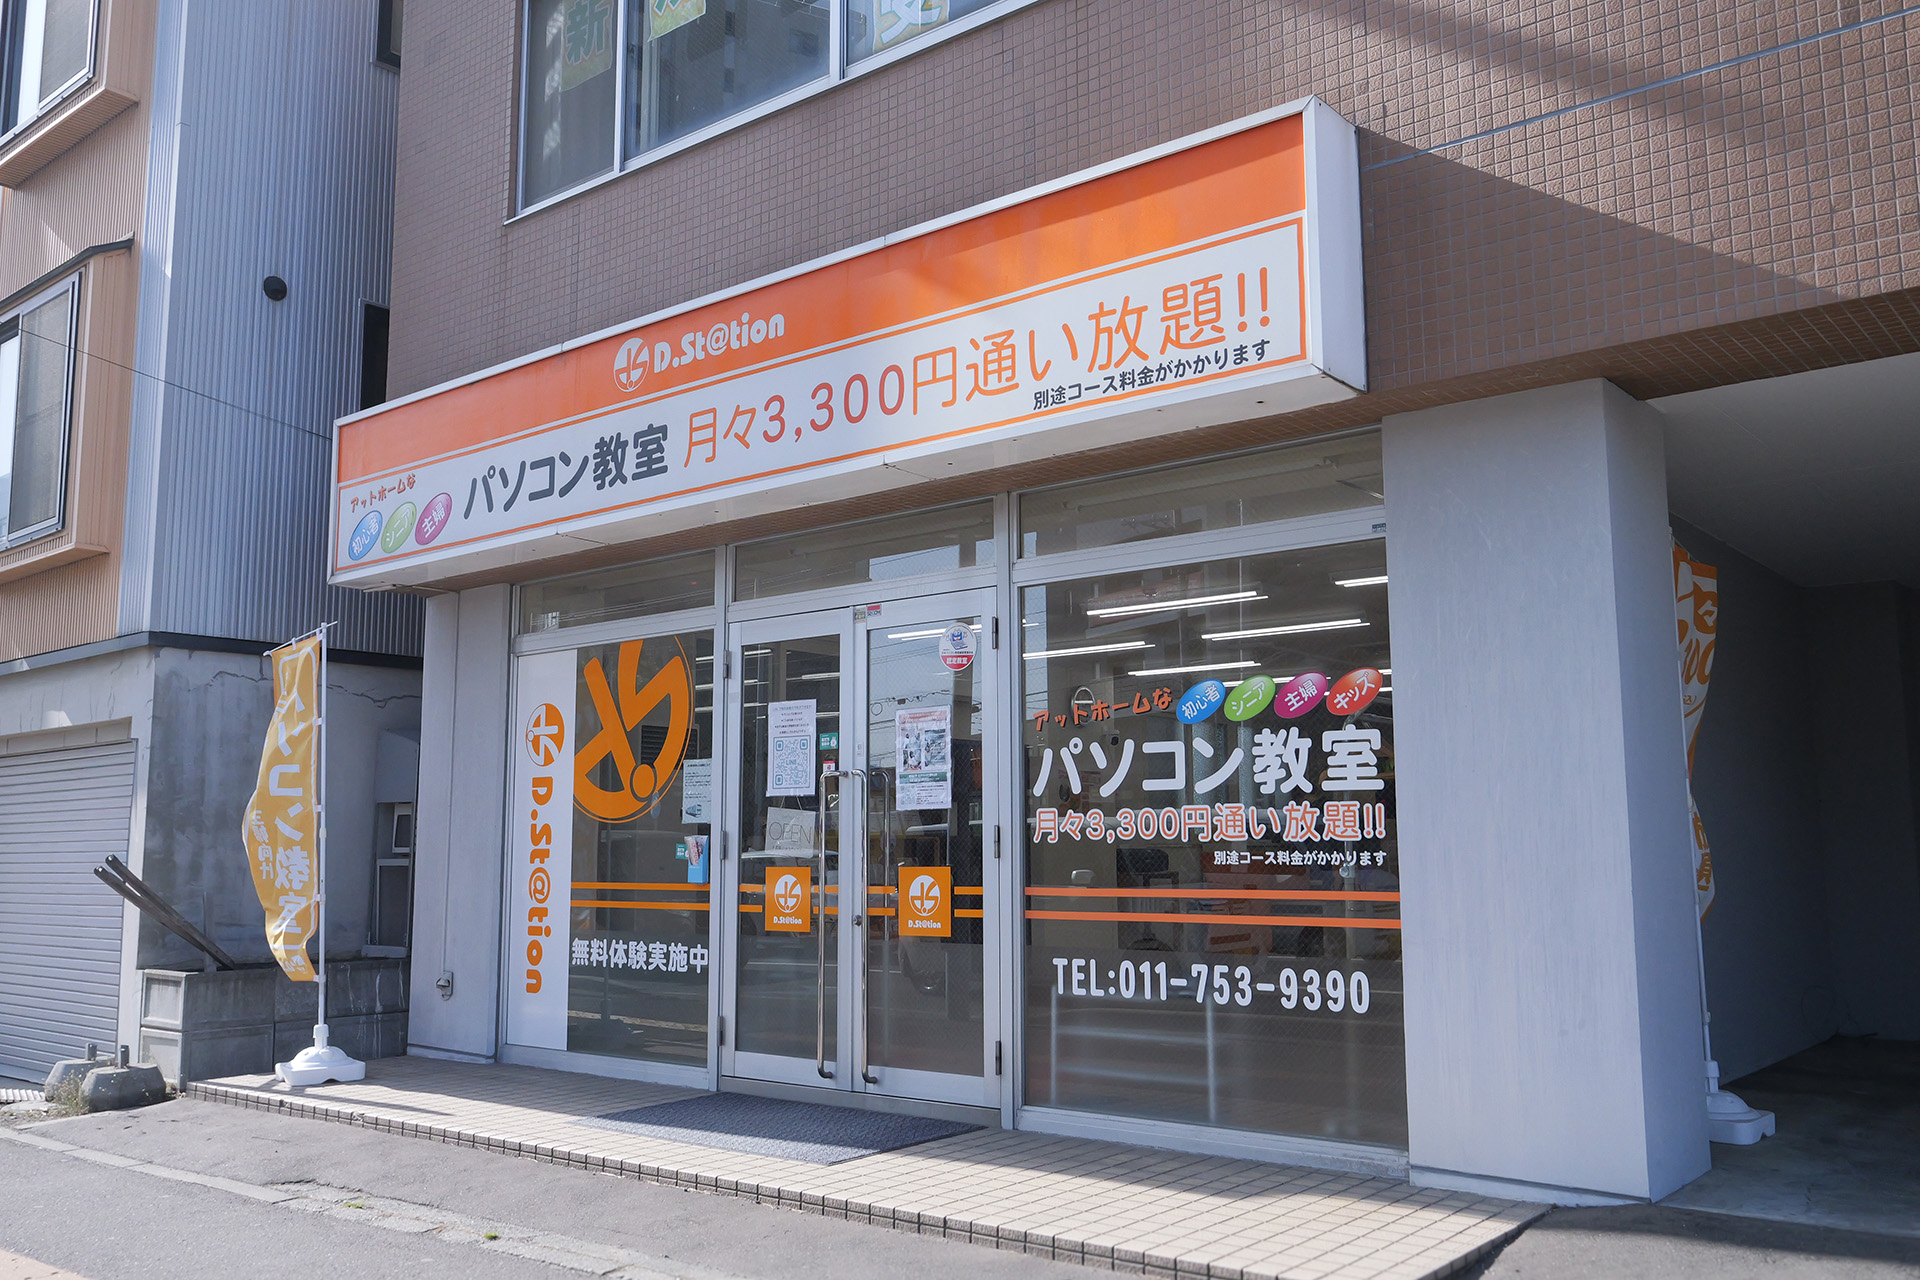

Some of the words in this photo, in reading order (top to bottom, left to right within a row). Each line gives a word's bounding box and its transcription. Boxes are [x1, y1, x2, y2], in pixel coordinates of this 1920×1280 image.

[653, 312, 785, 374] D.St@tion
[463, 423, 668, 520] パソコン教室
[683, 266, 1271, 469] 月々3,300円通い放題!!
[1032, 338, 1271, 411] 別途コース料金がかかります
[350, 473, 416, 513] アットホームな
[352, 517, 379, 556] 初心者
[385, 507, 411, 548] シニア
[421, 500, 446, 539] 主婦
[1033, 686, 1173, 732] アットホームな
[1181, 683, 1221, 720] 初心者
[1231, 680, 1267, 717] シニア
[1284, 678, 1318, 713] 主婦
[1333, 674, 1376, 710] キッズ
[1032, 724, 1385, 798] パソコン教室
[768, 821, 812, 844] OPEN
[1033, 800, 1387, 844] 月々3,300円通い放題!!
[1213, 850, 1387, 867] 別途コース料金がかかります
[525, 775, 554, 995] D.St@tion
[773, 915, 803, 926] D.St@tion
[908, 919, 942, 929] D.St@tion
[571, 937, 709, 974] 無料体験実施中
[1052, 957, 1370, 1015] TEL:011-753-9390
